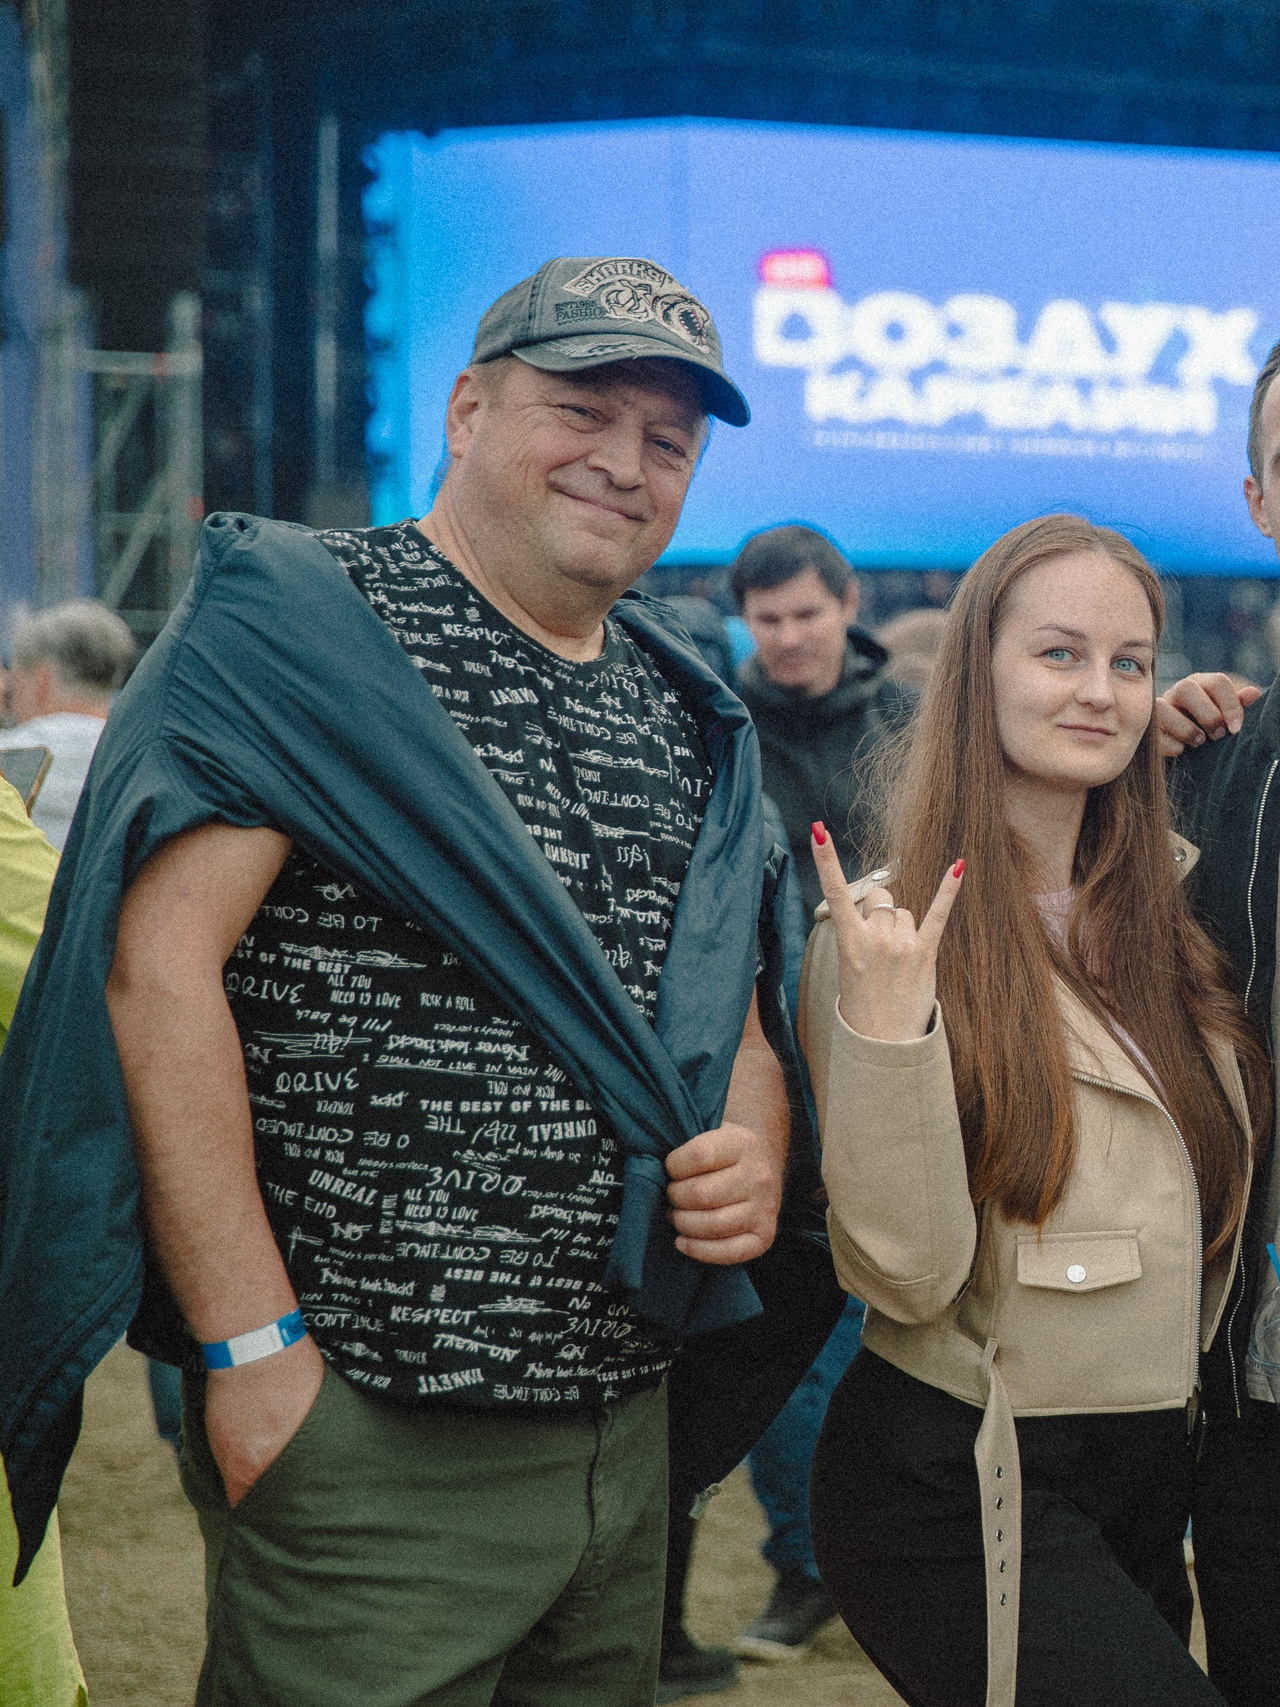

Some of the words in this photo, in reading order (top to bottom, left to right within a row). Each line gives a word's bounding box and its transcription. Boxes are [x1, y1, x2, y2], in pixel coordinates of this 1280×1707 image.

[283, 956, 311, 972] THE
[317, 960, 351, 975] BEST
[330, 990, 355, 1004] NEED
[375, 993, 401, 1009] LOVE
[420, 1100, 453, 1112] THE
[459, 1101, 503, 1113] BEST
[511, 1101, 532, 1112] OF
[540, 1101, 571, 1112] THE
[527, 1118, 597, 1143] UNREAL
[308, 1170, 378, 1206] UNREAL
[403, 1189, 422, 1200] ALL
[428, 1190, 450, 1203] YOU
[304, 1195, 337, 1219] END
[404, 1205, 431, 1217] NEED
[452, 1207, 479, 1221] LOVE
[444, 1268, 484, 1281] BEST
[489, 1271, 521, 1285] THE
[390, 1305, 477, 1326] RESPECT
